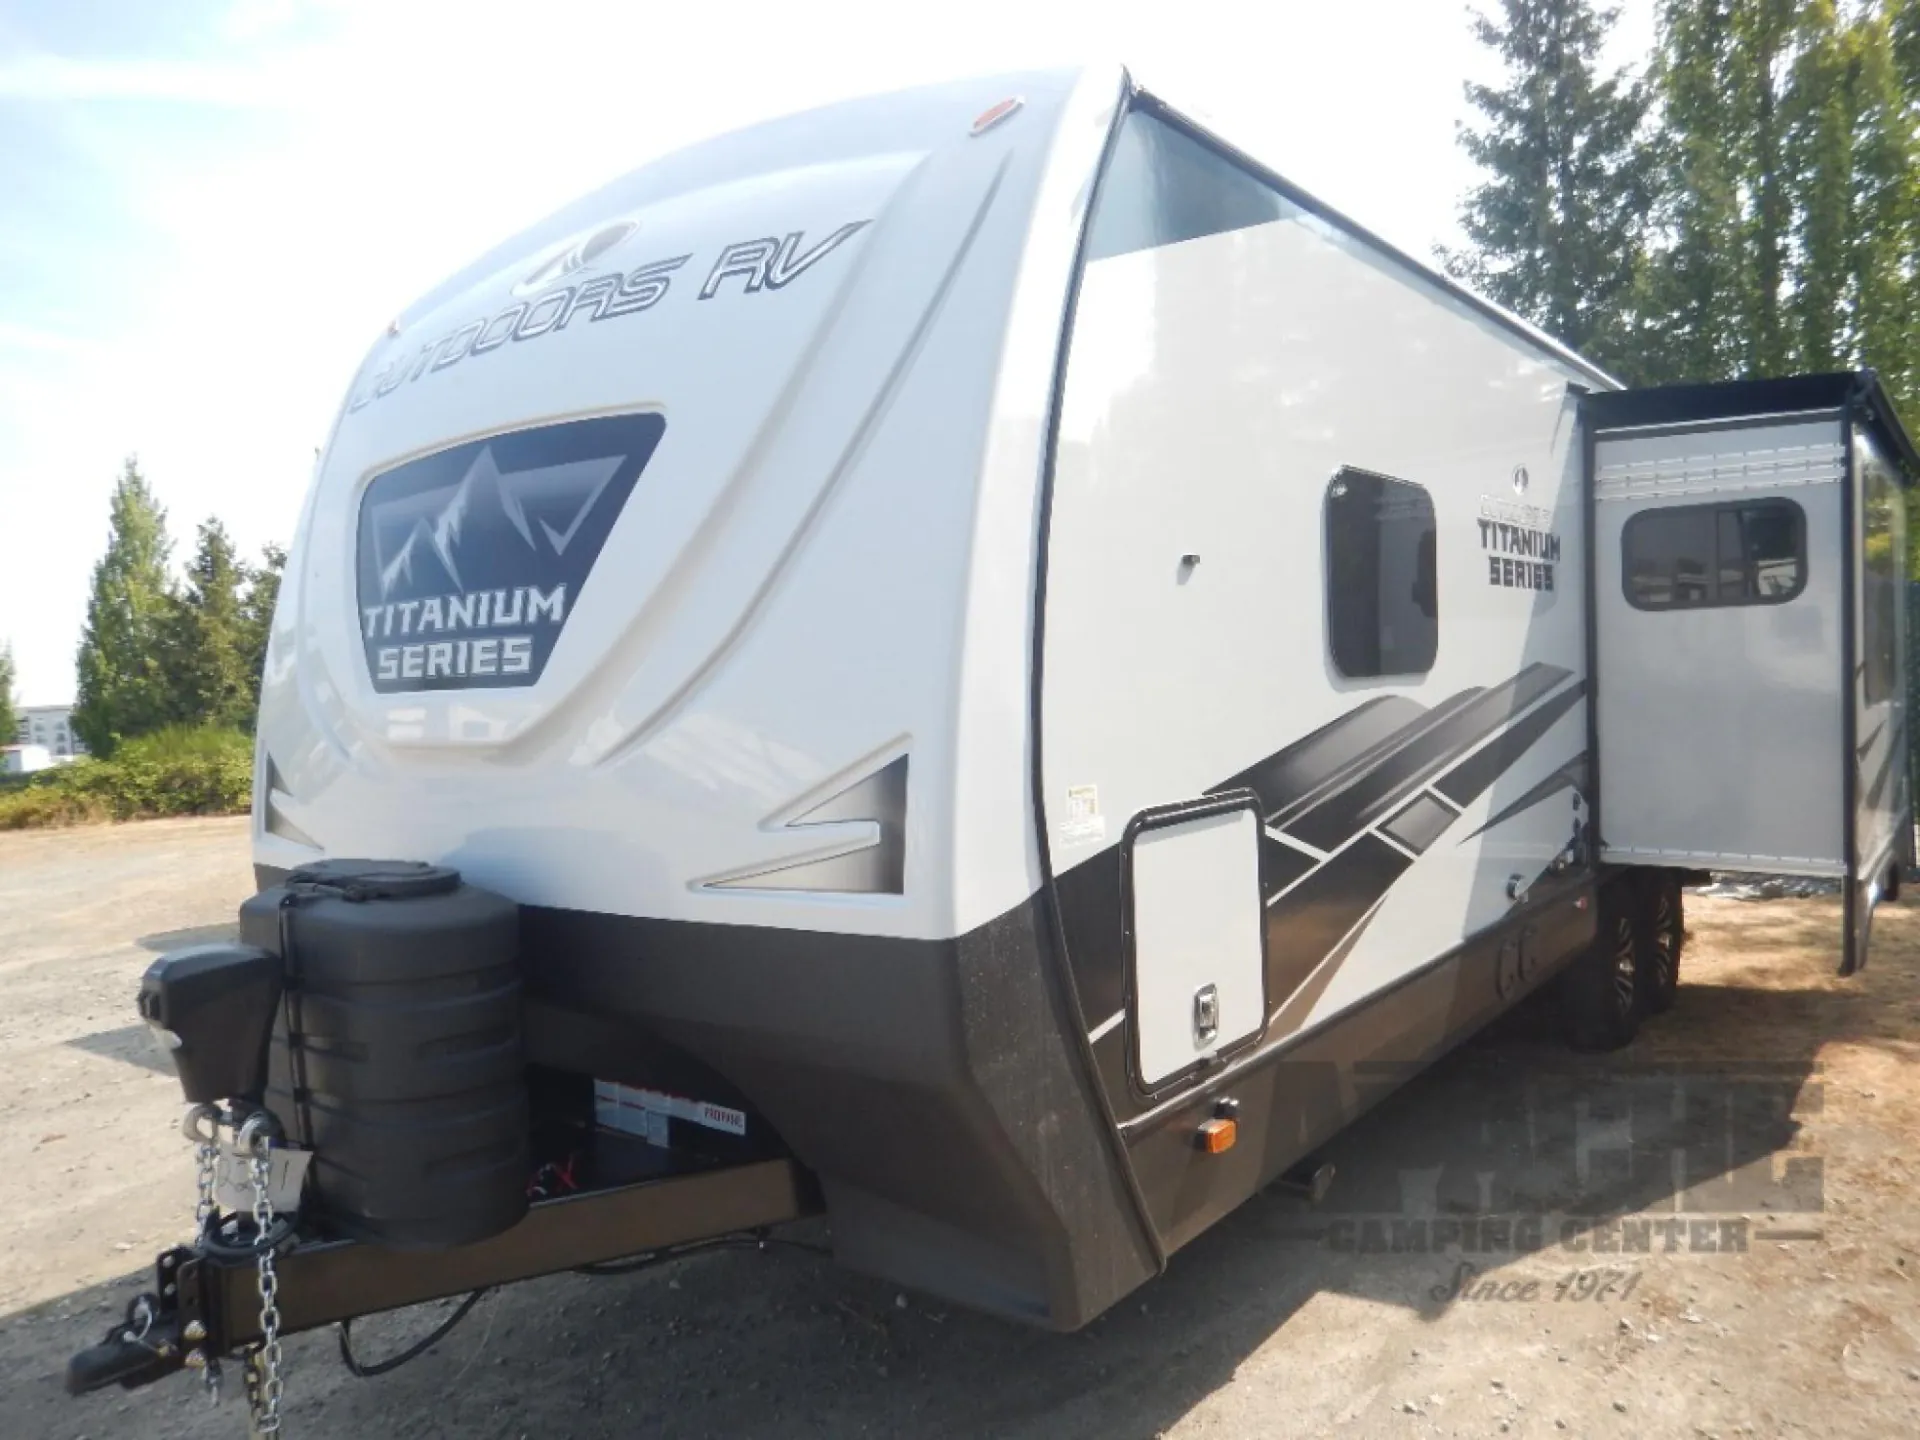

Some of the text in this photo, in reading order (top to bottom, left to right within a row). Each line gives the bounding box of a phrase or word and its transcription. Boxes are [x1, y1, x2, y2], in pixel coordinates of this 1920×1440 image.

[697, 218, 874, 301] RV
[1477, 516, 1561, 563] TITANIUM
[1488, 555, 1554, 592] SERIES
[363, 581, 568, 640] TITANIUM
[376, 634, 534, 681] SERIES
